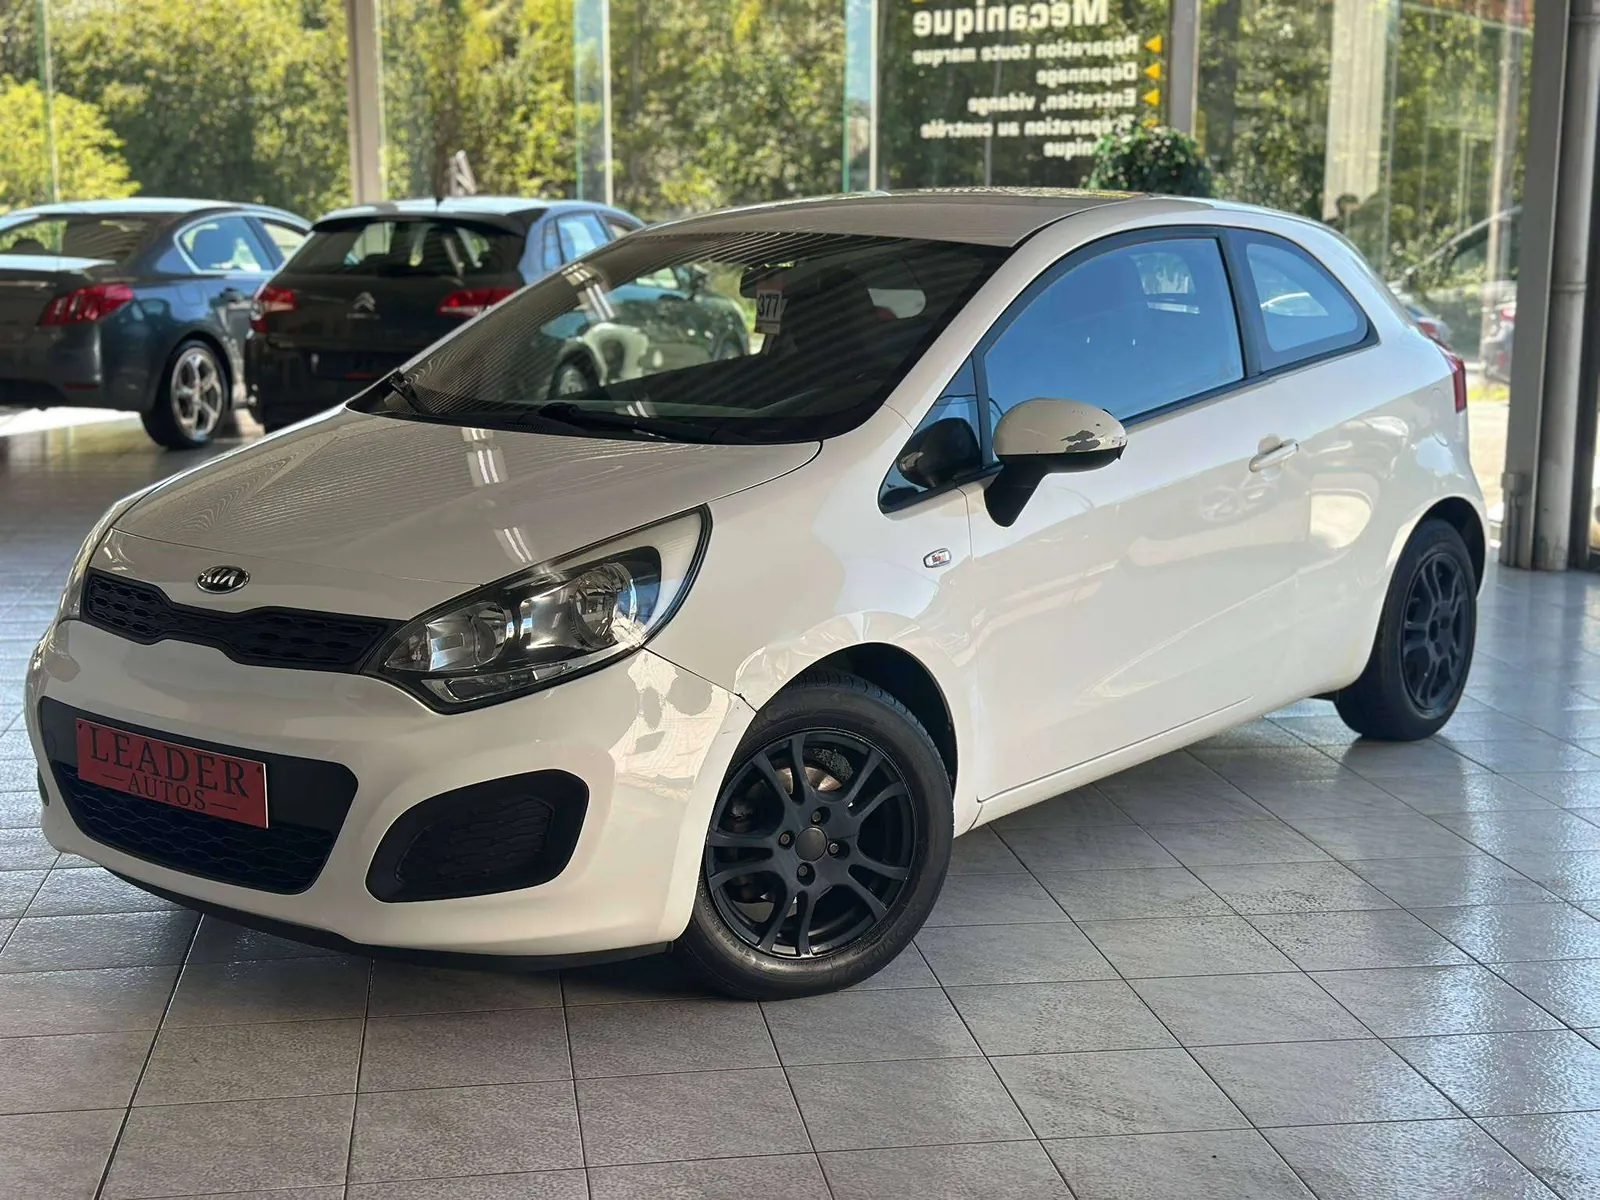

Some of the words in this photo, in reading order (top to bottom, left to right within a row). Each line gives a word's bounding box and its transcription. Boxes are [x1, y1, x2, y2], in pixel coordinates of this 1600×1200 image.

[758, 293, 780, 317] 377
[89, 726, 249, 798] LEADER
[128, 773, 206, 810] AUTOS
